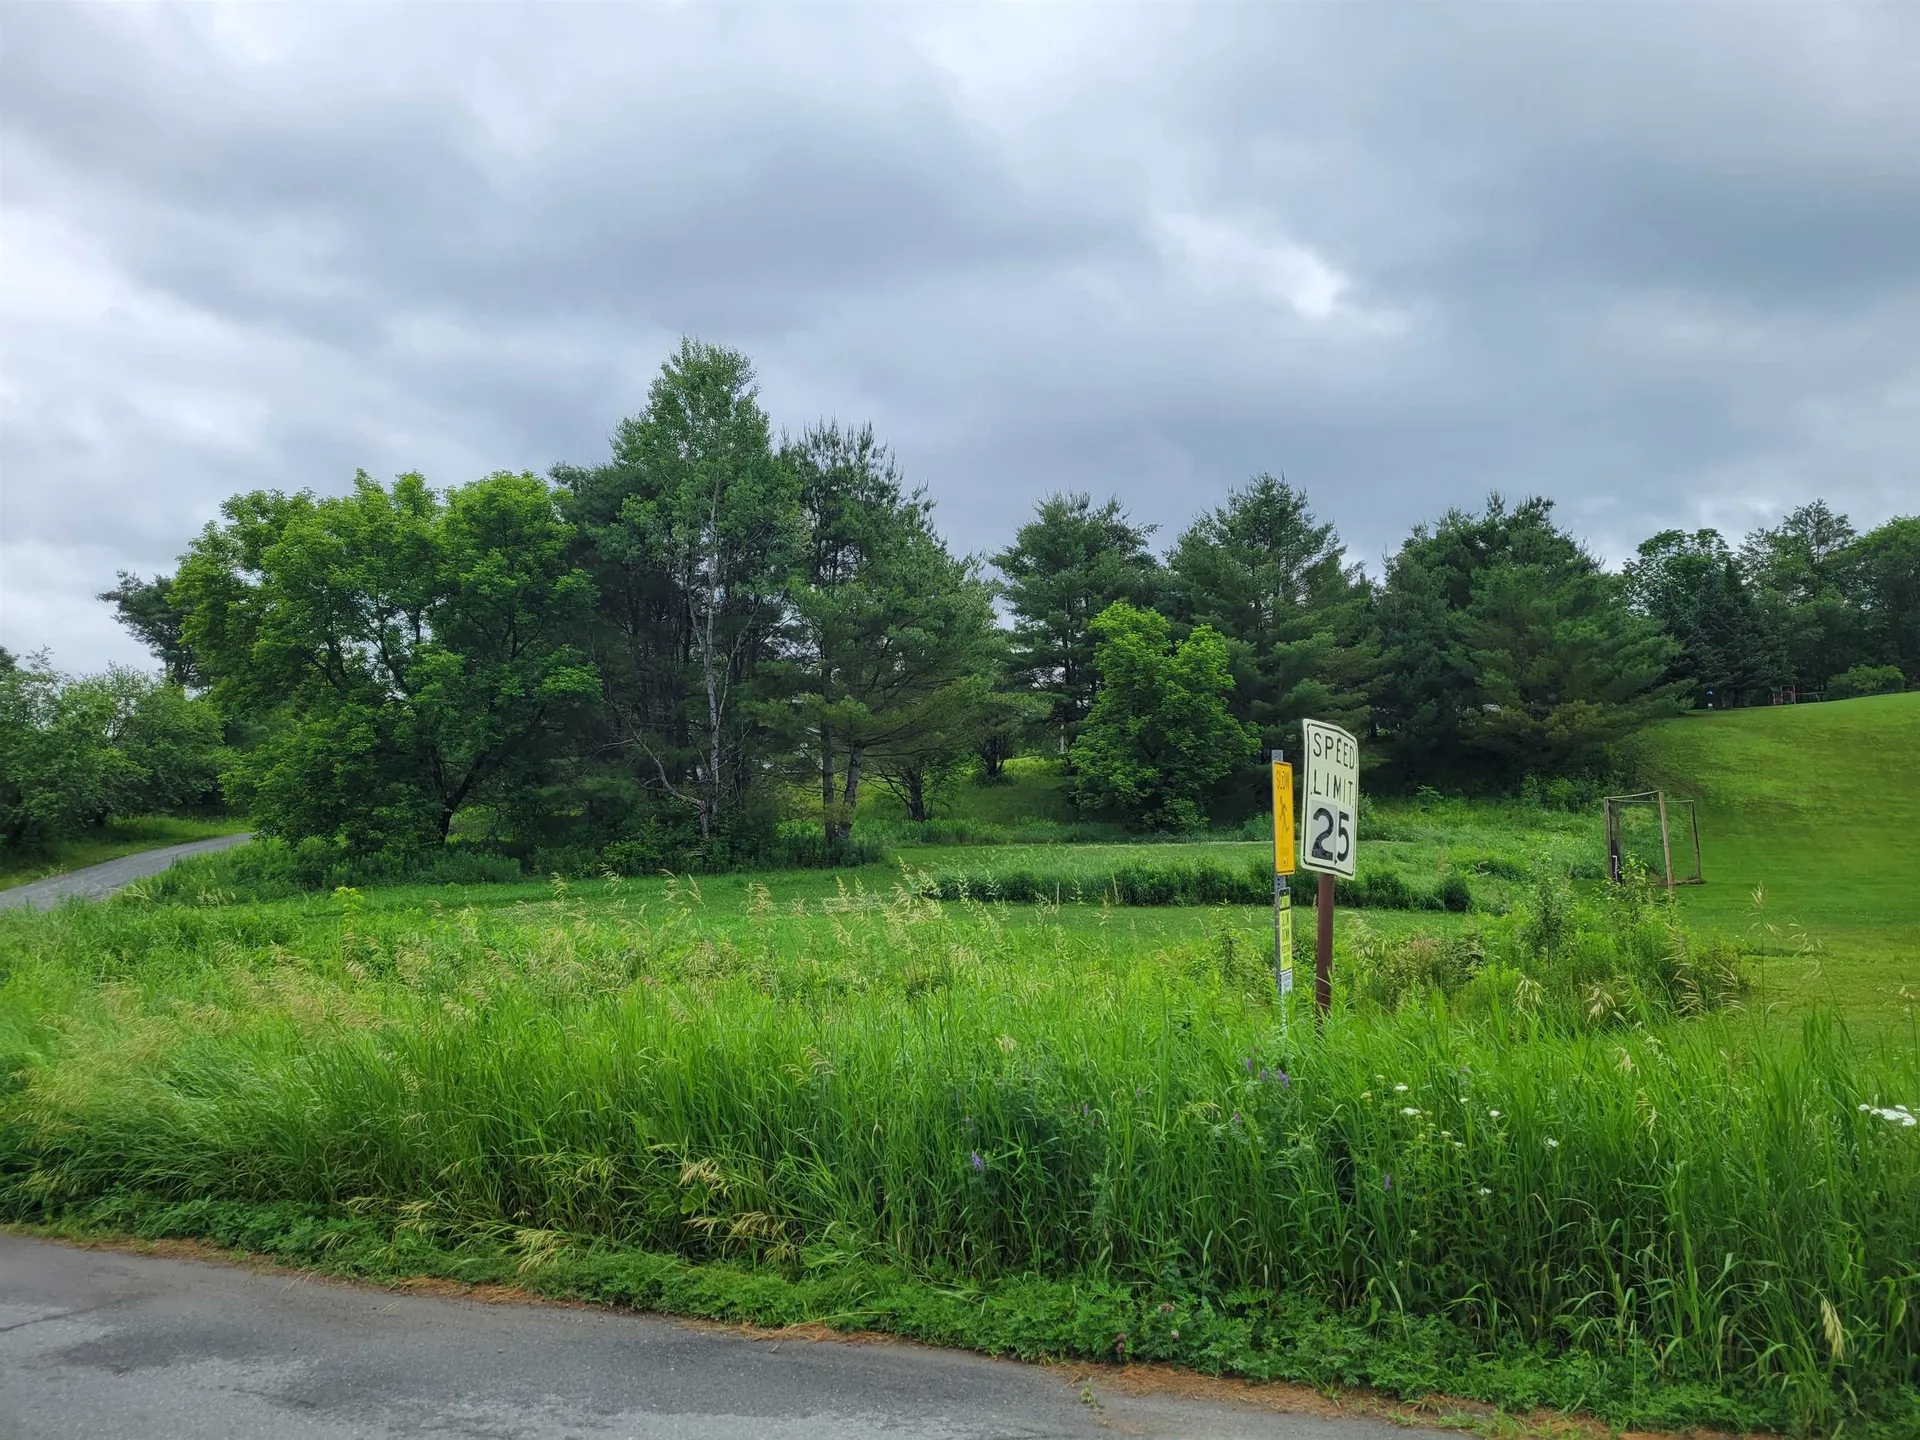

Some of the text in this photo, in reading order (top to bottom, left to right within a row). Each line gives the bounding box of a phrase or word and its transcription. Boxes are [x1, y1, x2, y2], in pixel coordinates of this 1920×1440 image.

[1312, 732, 1355, 770] SPEED
[1313, 769, 1353, 806] LIMIT
[1311, 807, 1350, 863] 25
